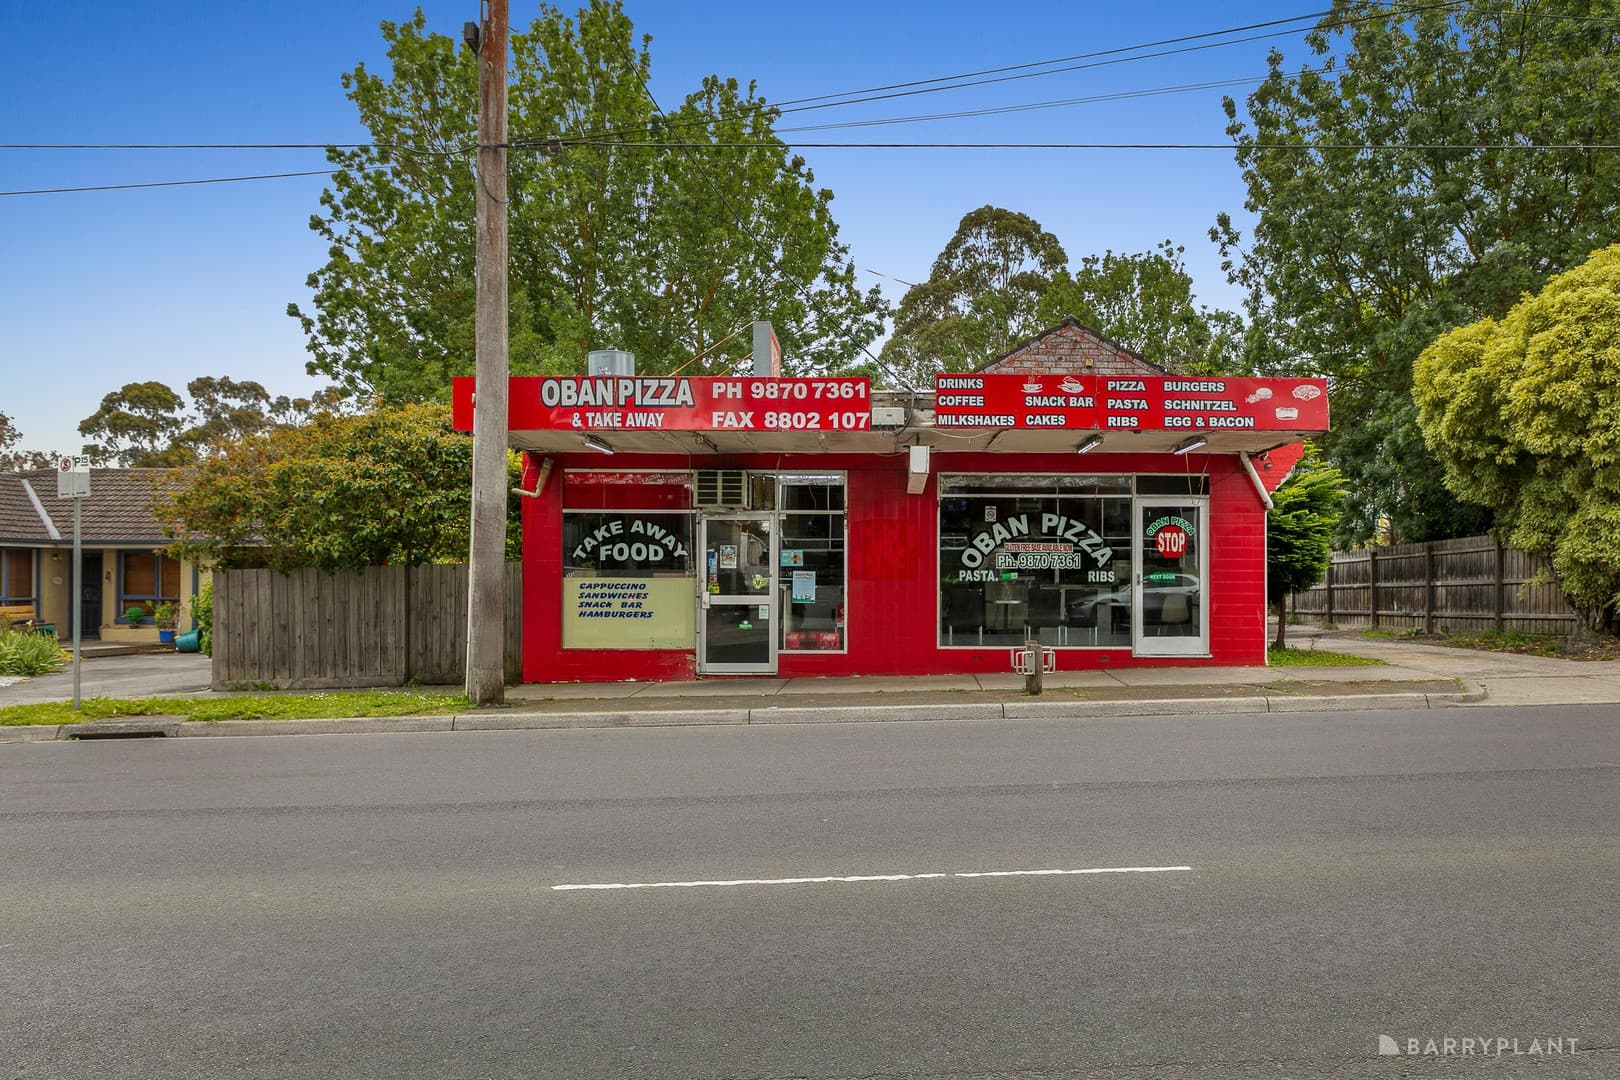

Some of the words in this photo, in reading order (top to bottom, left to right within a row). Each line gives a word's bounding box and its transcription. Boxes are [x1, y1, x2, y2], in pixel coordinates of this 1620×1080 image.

[938, 378, 984, 389] DRINKS
[1107, 381, 1146, 391] PIZZA
[1164, 382, 1225, 392] BURGERS
[541, 378, 614, 407] OBAN
[617, 378, 695, 407] PIZZA
[712, 383, 742, 399] PH
[751, 382, 808, 399] 9870
[811, 382, 866, 399] 7361
[938, 396, 984, 406] COFFEE
[1025, 396, 1066, 407] SNACK
[1069, 396, 1094, 407] BAR
[1107, 399, 1149, 409] PASTA
[1164, 400, 1237, 411] SCHNITZEL
[572, 413, 582, 427] &
[585, 413, 622, 428] TAKE
[625, 413, 665, 428] AWAY
[712, 411, 754, 428] FAX
[764, 411, 820, 429] 8802
[828, 412, 870, 429] 107
[938, 415, 1015, 426] MILKSHAKES
[1025, 415, 1066, 425] CAKES
[1107, 417, 1139, 427] RIBS
[1164, 417, 1192, 427] EGG
[1195, 417, 1205, 427] &
[1209, 417, 1254, 427] BACON
[1146, 516, 1170, 536] OBAN
[1171, 516, 1194, 536] PIZZA
[572, 520, 624, 560] TAKE
[630, 519, 689, 558] AWAY
[961, 514, 1030, 568] OBAN
[1041, 513, 1113, 568] PIZZA
[1158, 532, 1186, 552] STOP
[600, 542, 664, 561] FOOD
[997, 554, 1017, 568] Ph.
[1018, 553, 1049, 569] 9870
[1050, 553, 1080, 569] 7361
[1088, 571, 1115, 583] RIBS
[578, 592, 649, 600] SANDWICHES
